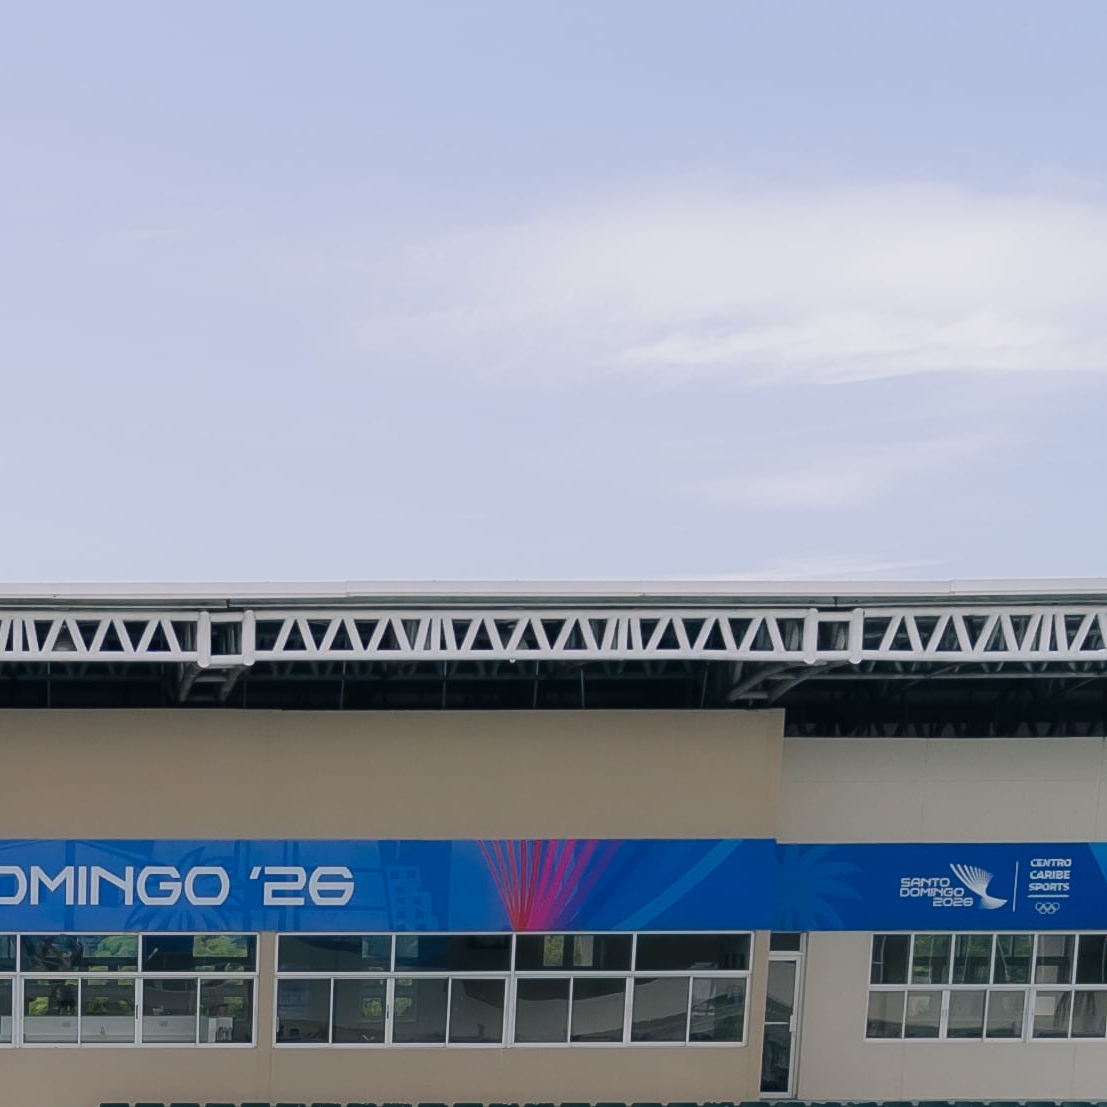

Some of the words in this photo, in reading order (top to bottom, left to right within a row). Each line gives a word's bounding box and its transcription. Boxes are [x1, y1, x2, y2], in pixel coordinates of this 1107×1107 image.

[1030, 858, 1072, 867] CENTRO
[1030, 870, 1071, 880] CARIBE
[249, 866, 355, 906] '26
[901, 878, 950, 888] SANTO
[1028, 882, 1070, 892] SPORTS
[900, 888, 965, 898] DOMINGO
